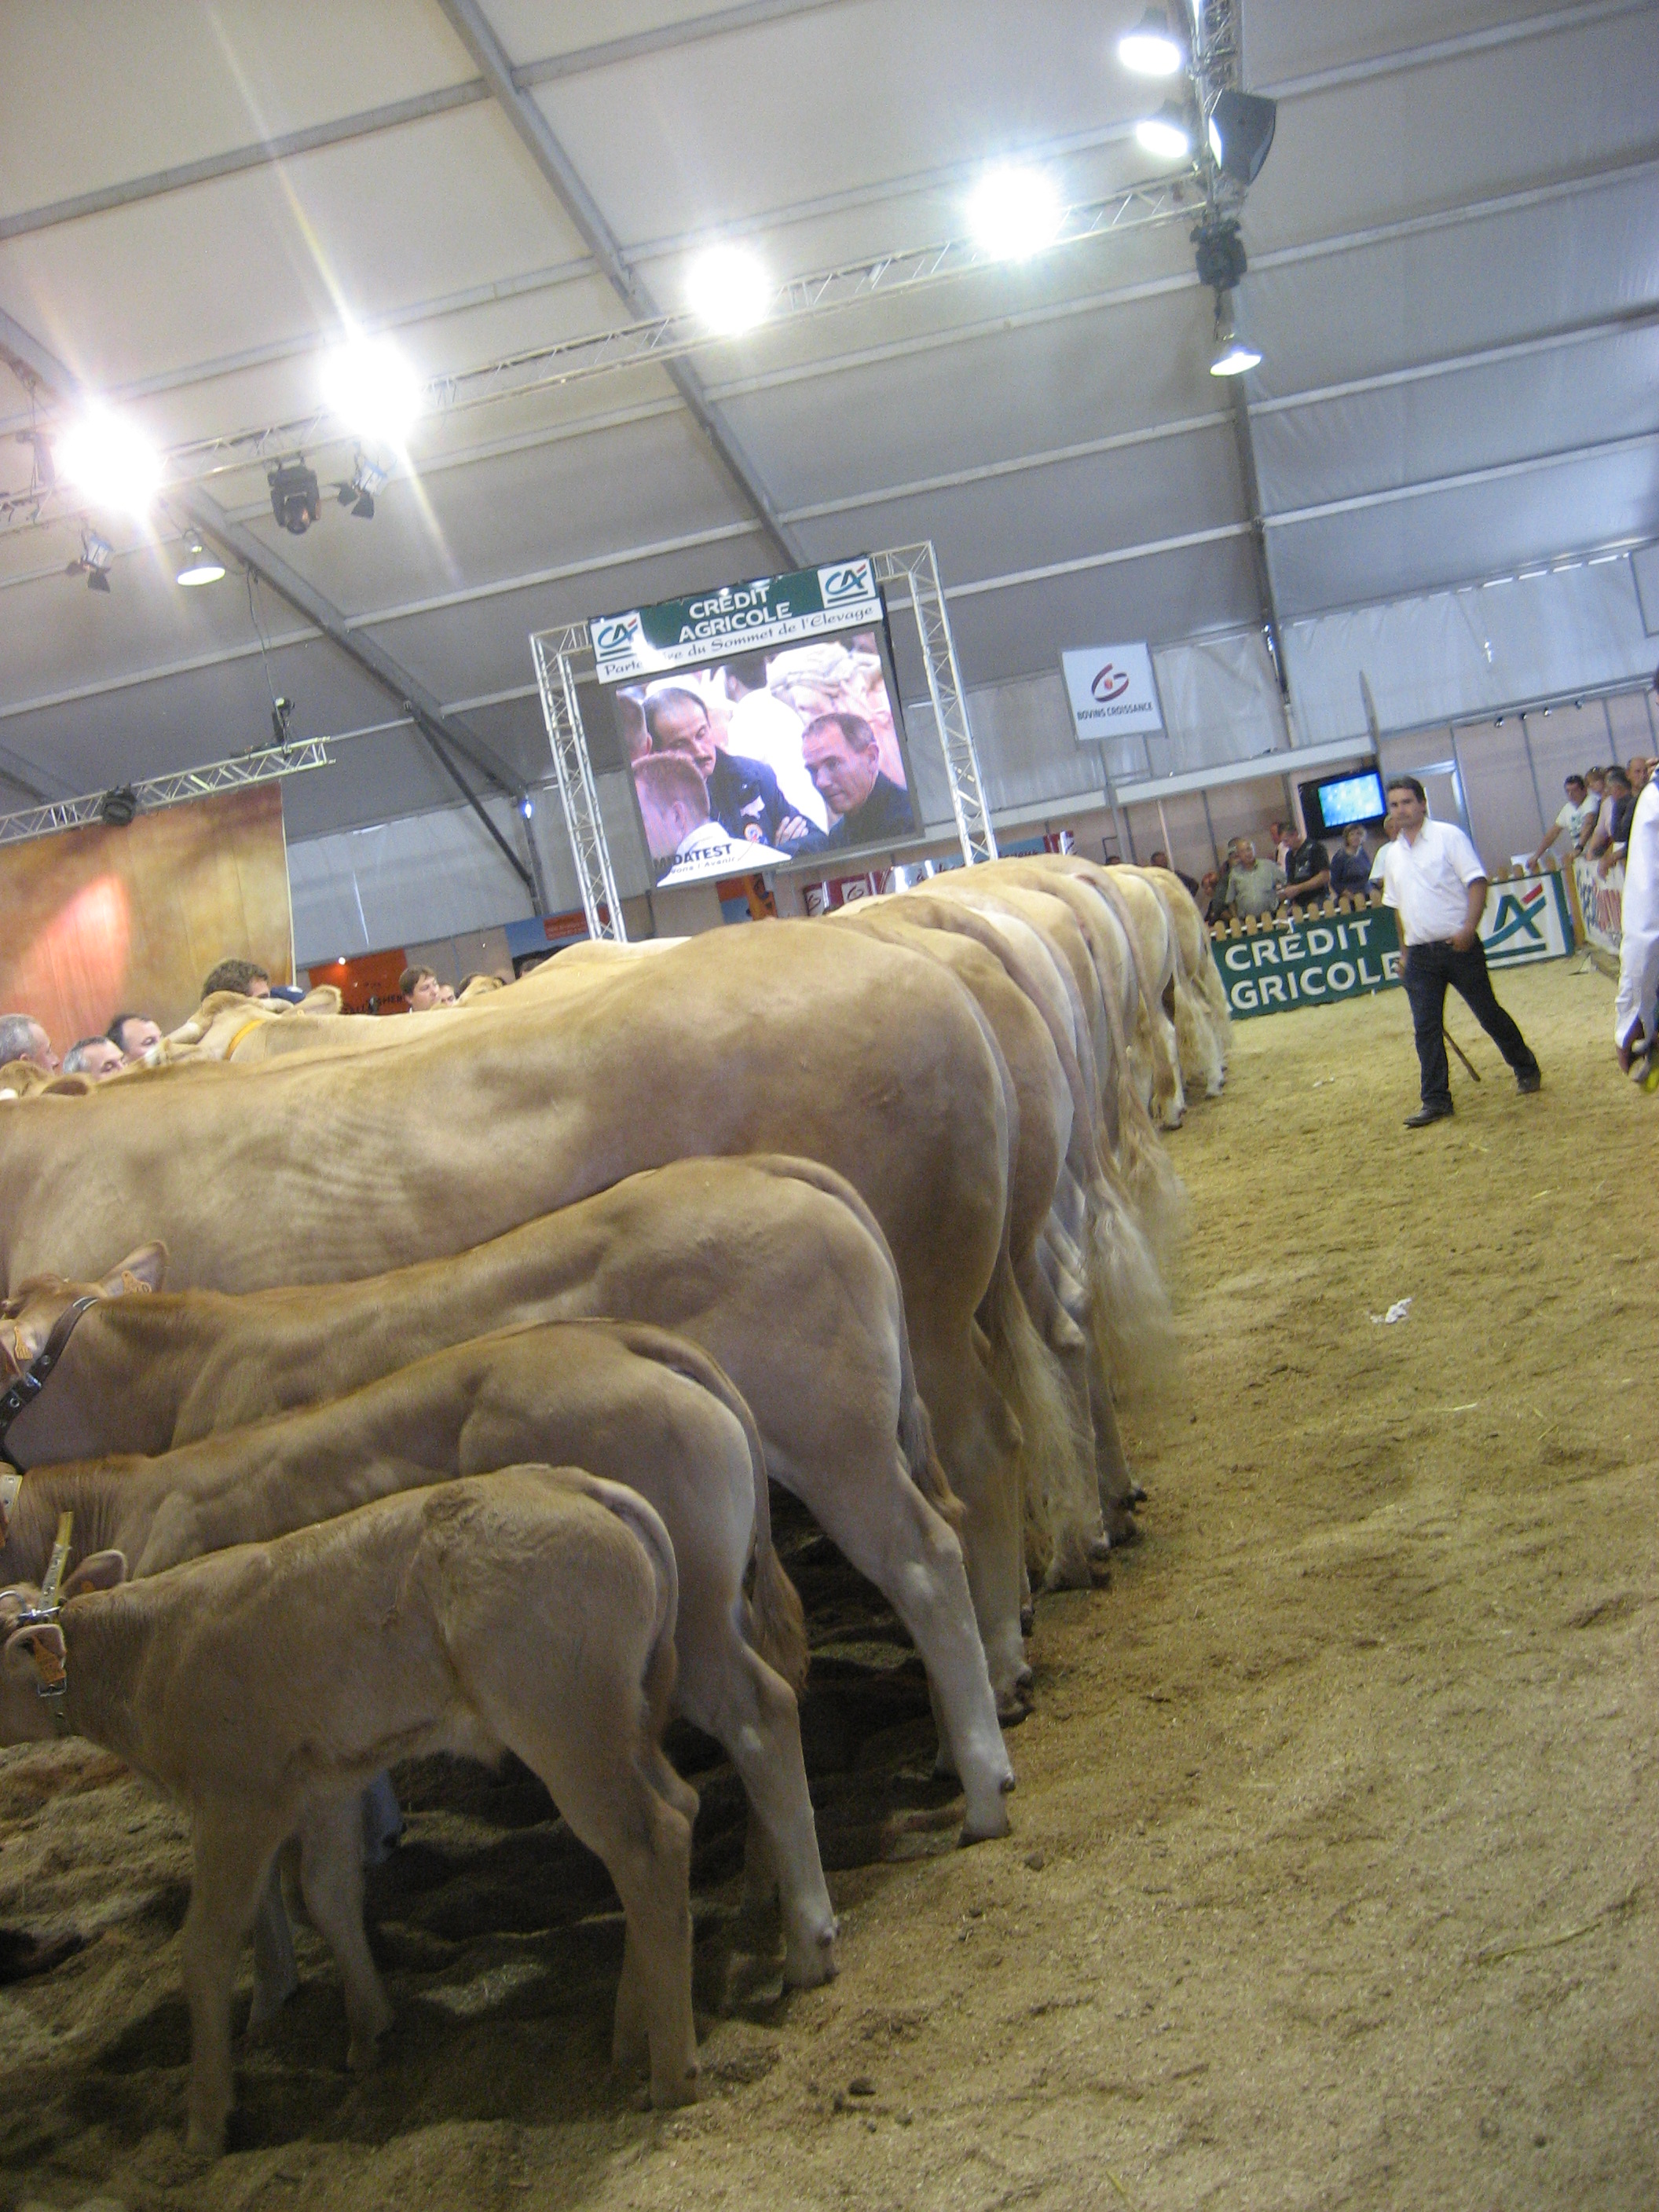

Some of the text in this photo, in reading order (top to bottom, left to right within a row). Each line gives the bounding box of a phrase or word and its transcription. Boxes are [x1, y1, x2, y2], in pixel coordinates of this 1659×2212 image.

[679, 602, 793, 643] AGRICOLE
[687, 643, 706, 659] du
[711, 628, 774, 654] Sommet
[778, 622, 797, 636] de
[1076, 701, 1153, 721] BOVINS CROISSANCE
[1229, 950, 1401, 1011] GRICOLE
